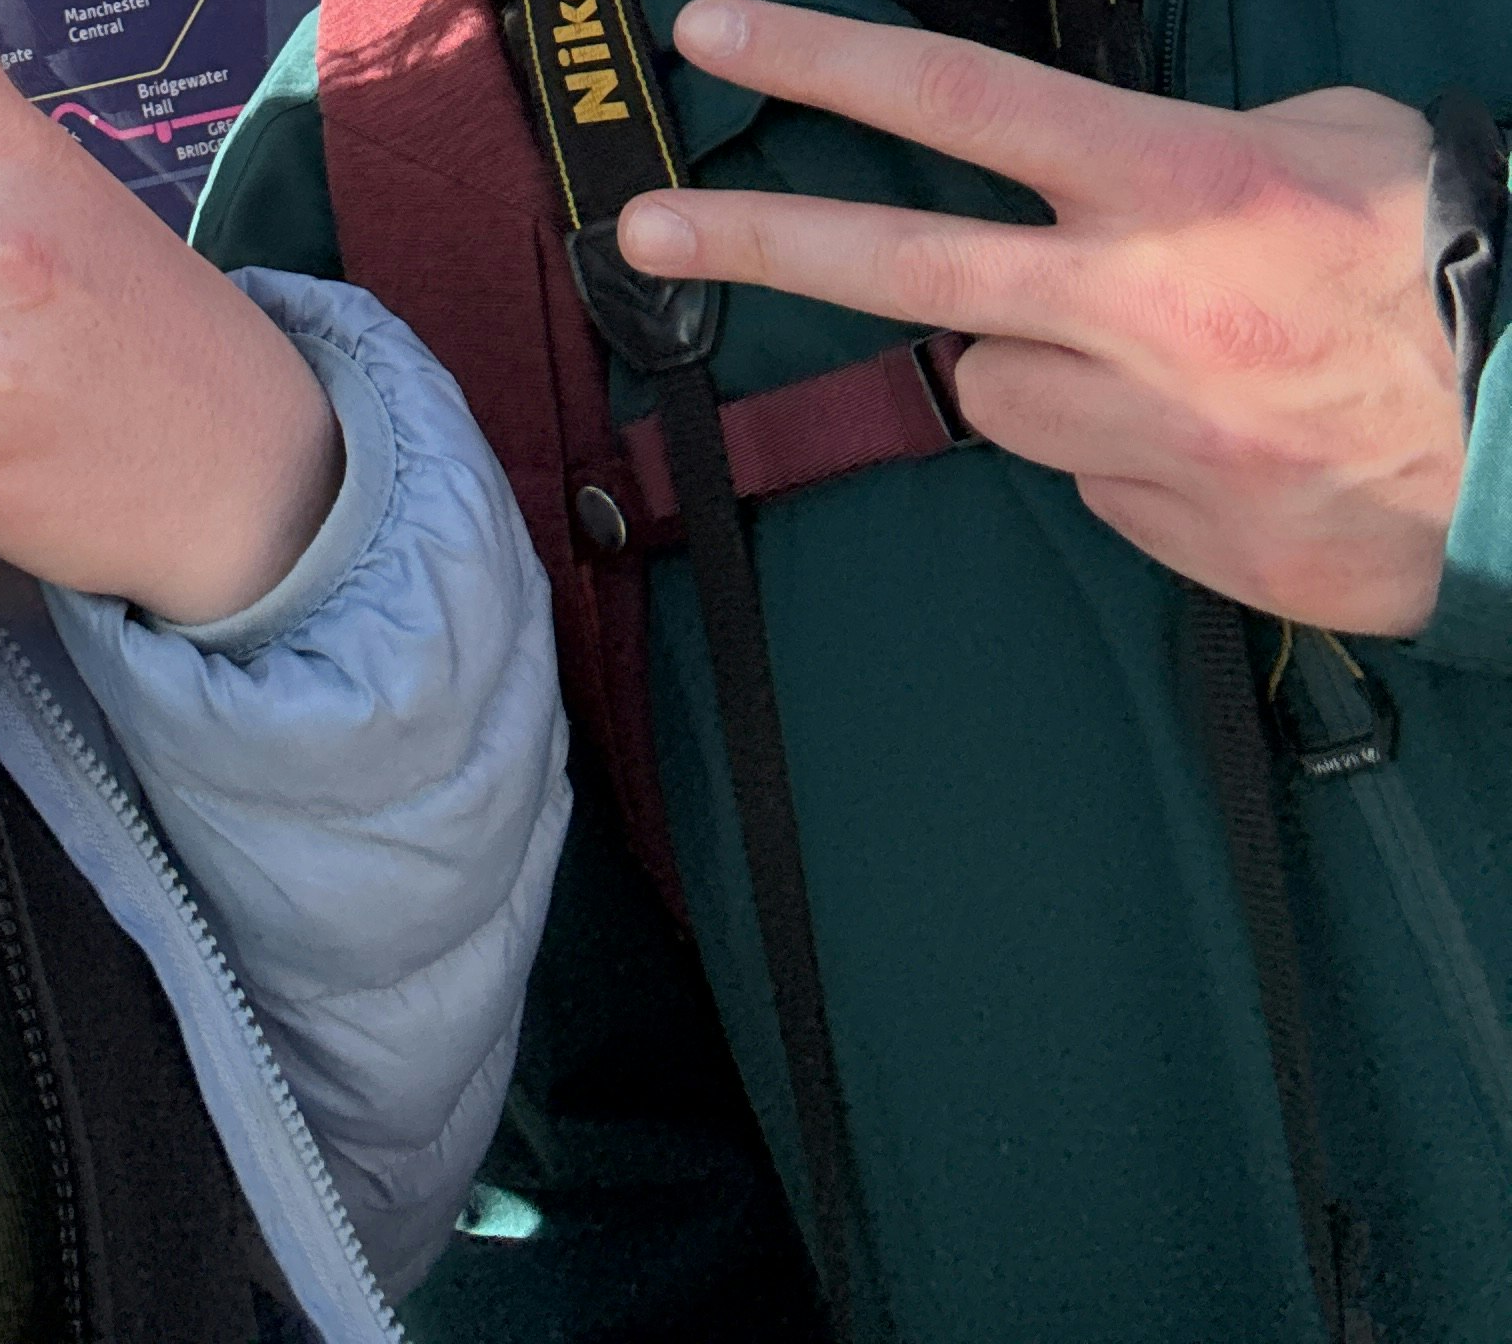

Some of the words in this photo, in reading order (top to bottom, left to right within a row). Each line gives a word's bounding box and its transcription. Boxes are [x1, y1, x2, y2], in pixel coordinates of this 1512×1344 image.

[68, 18, 124, 43] Central
[138, 69, 229, 99] Bridgewater
[141, 98, 174, 119] Hall
